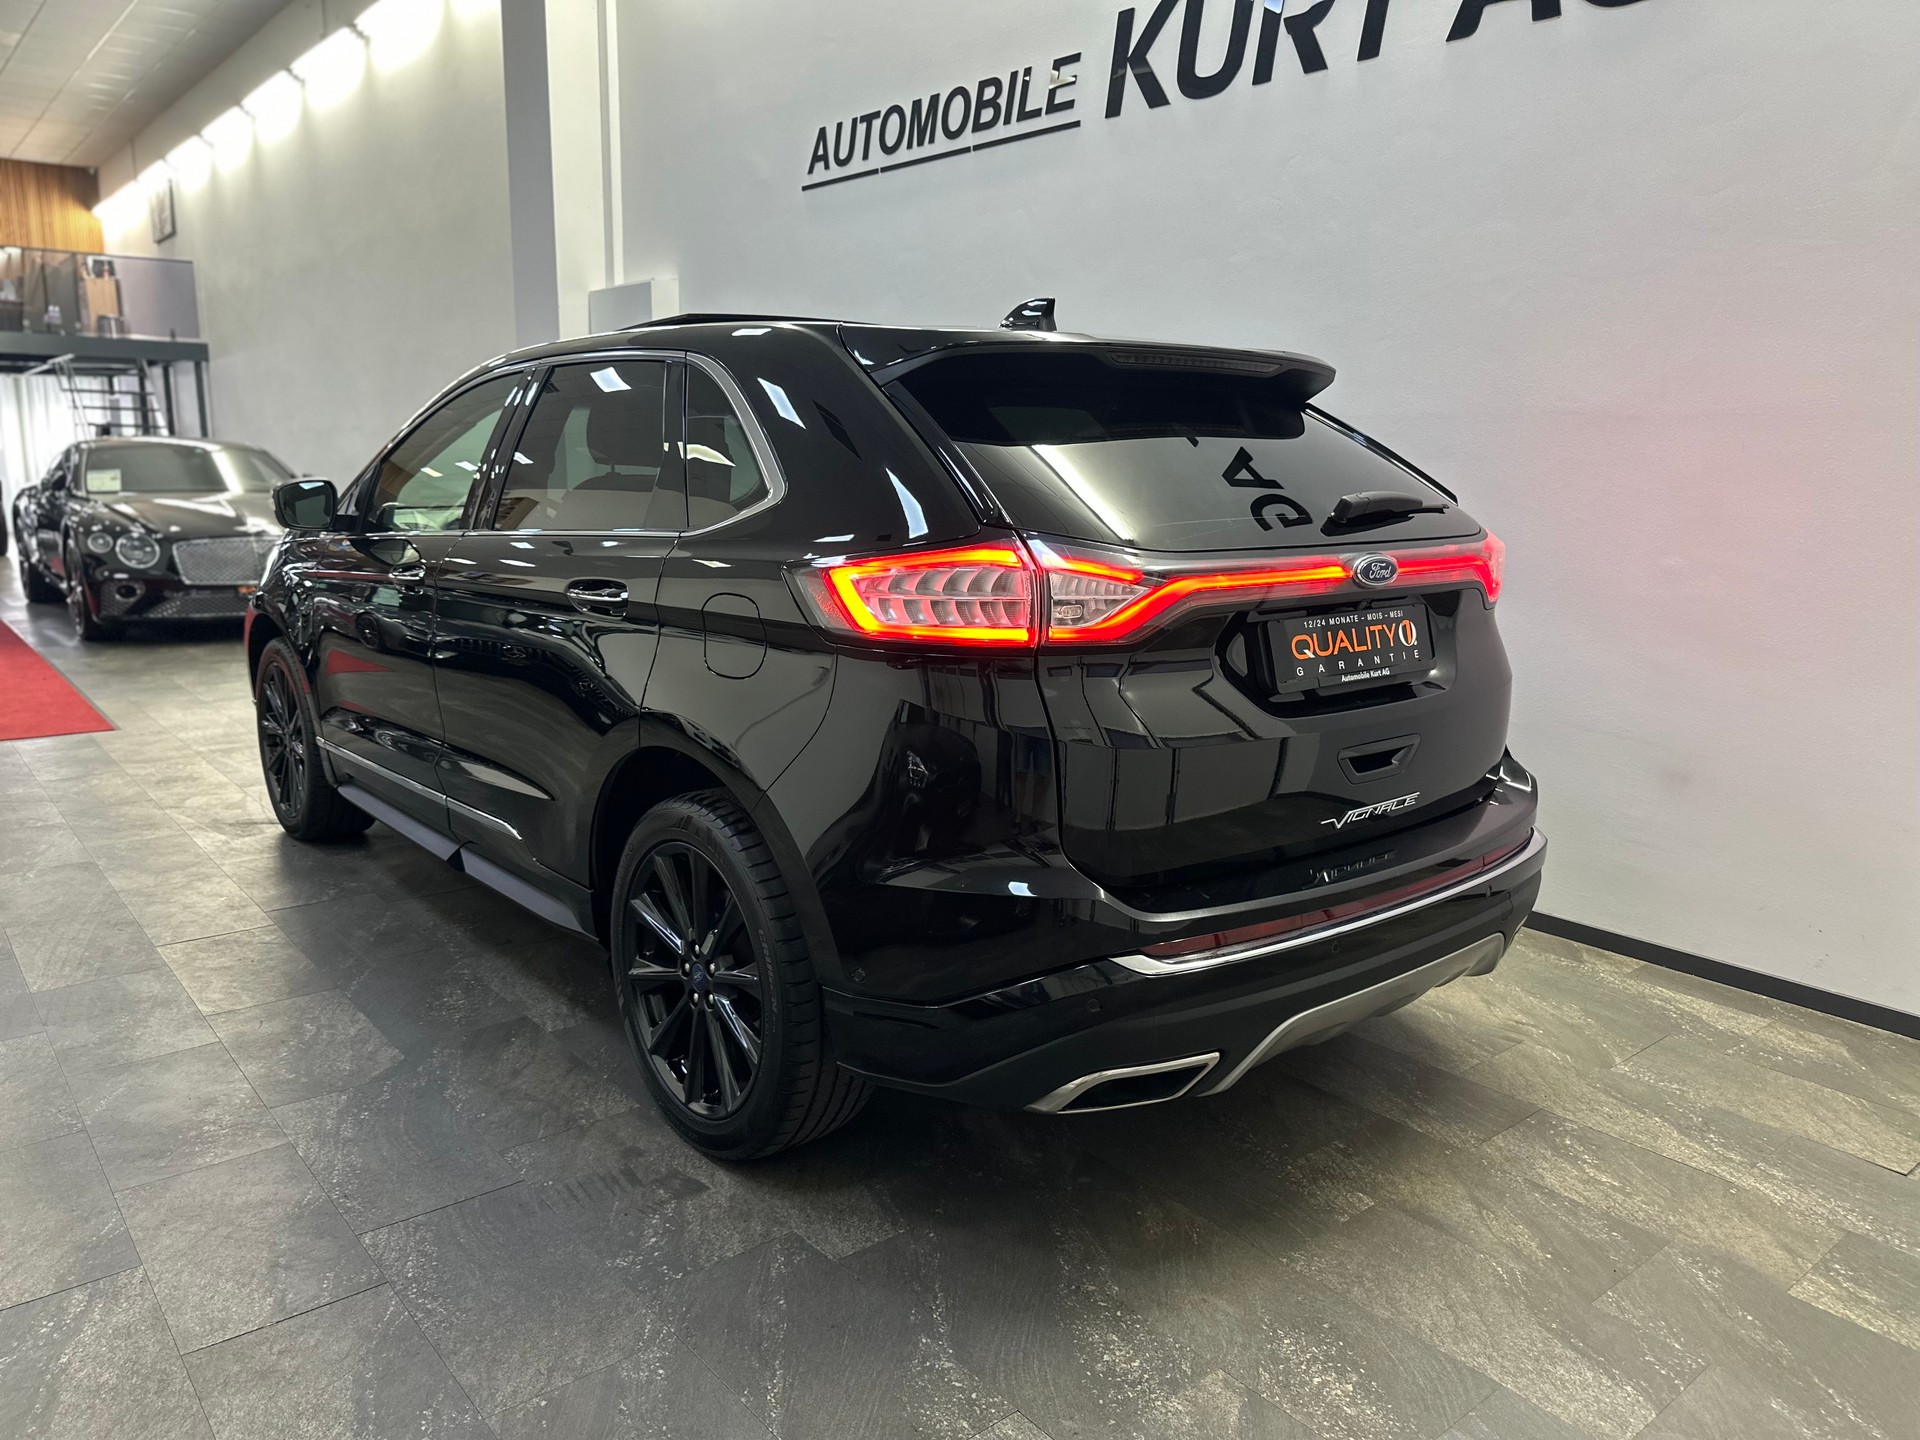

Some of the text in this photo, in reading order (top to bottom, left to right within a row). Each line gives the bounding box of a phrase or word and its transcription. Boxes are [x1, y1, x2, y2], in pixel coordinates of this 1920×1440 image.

[807, 52, 1082, 175] AUTOMOBILE
[1369, 562, 1392, 579] Ford
[1303, 619, 1326, 629] 12/24
[1329, 614, 1359, 626] MONATE
[1367, 612, 1383, 621] MOIS
[1389, 610, 1404, 618] MESI
[1341, 667, 1391, 682] Automobile Kurt AG
[1320, 791, 1420, 829] VIGNALE
